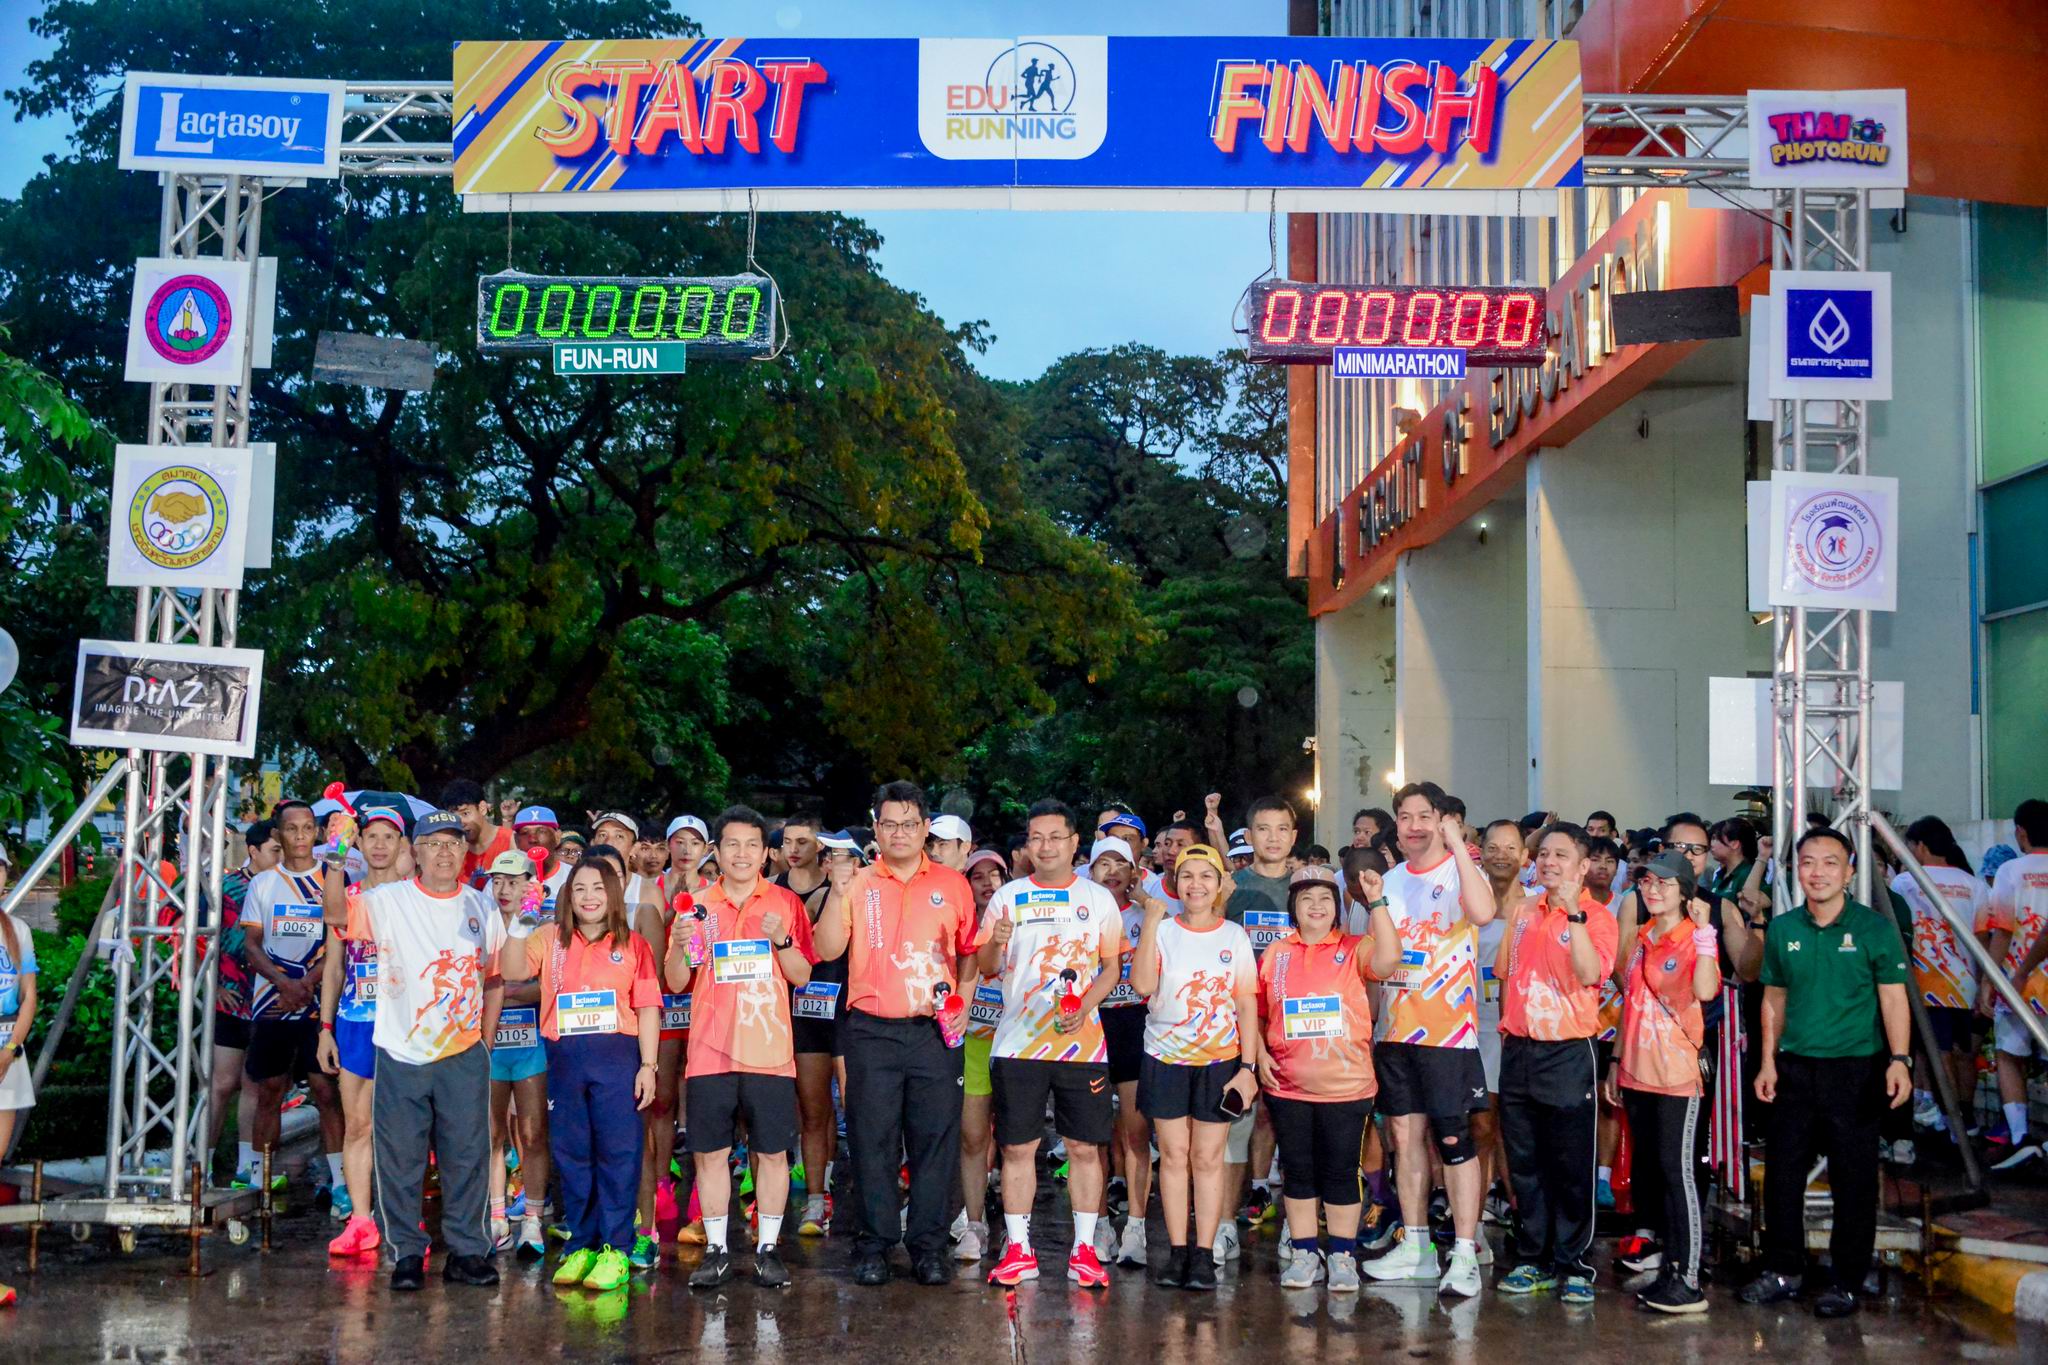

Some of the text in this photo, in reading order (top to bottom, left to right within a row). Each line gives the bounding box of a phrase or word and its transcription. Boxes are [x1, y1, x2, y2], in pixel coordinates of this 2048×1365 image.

[946, 85, 1008, 110] EDU
[534, 56, 828, 158] START
[1207, 58, 1498, 155] FINISH
[155, 92, 302, 154] Lactasoy
[946, 118, 1076, 140] RUNNING
[1768, 111, 1853, 143] THAI
[1770, 141, 1890, 167] PHOTORUN
[561, 348, 658, 369] FUN-RUN
[1337, 352, 1459, 376] MINIMARATHON
[1442, 389, 1476, 488] OF
[95, 703, 139, 716] IMAGINE
[144, 707, 163, 717] THE
[428, 812, 457, 824] MSU
[1302, 868, 1324, 880] NY
[1032, 907, 1056, 917] VIP
[283, 921, 315, 933] 0062
[732, 961, 757, 974] VIP
[571, 994, 602, 1008] Lactasoy
[802, 1000, 828, 1011] 0121
[1296, 1000, 1327, 1013] Lactasoy
[576, 1013, 601, 1026] VIP
[1303, 1018, 1327, 1031] VIP
[495, 1029, 529, 1042] 0105
